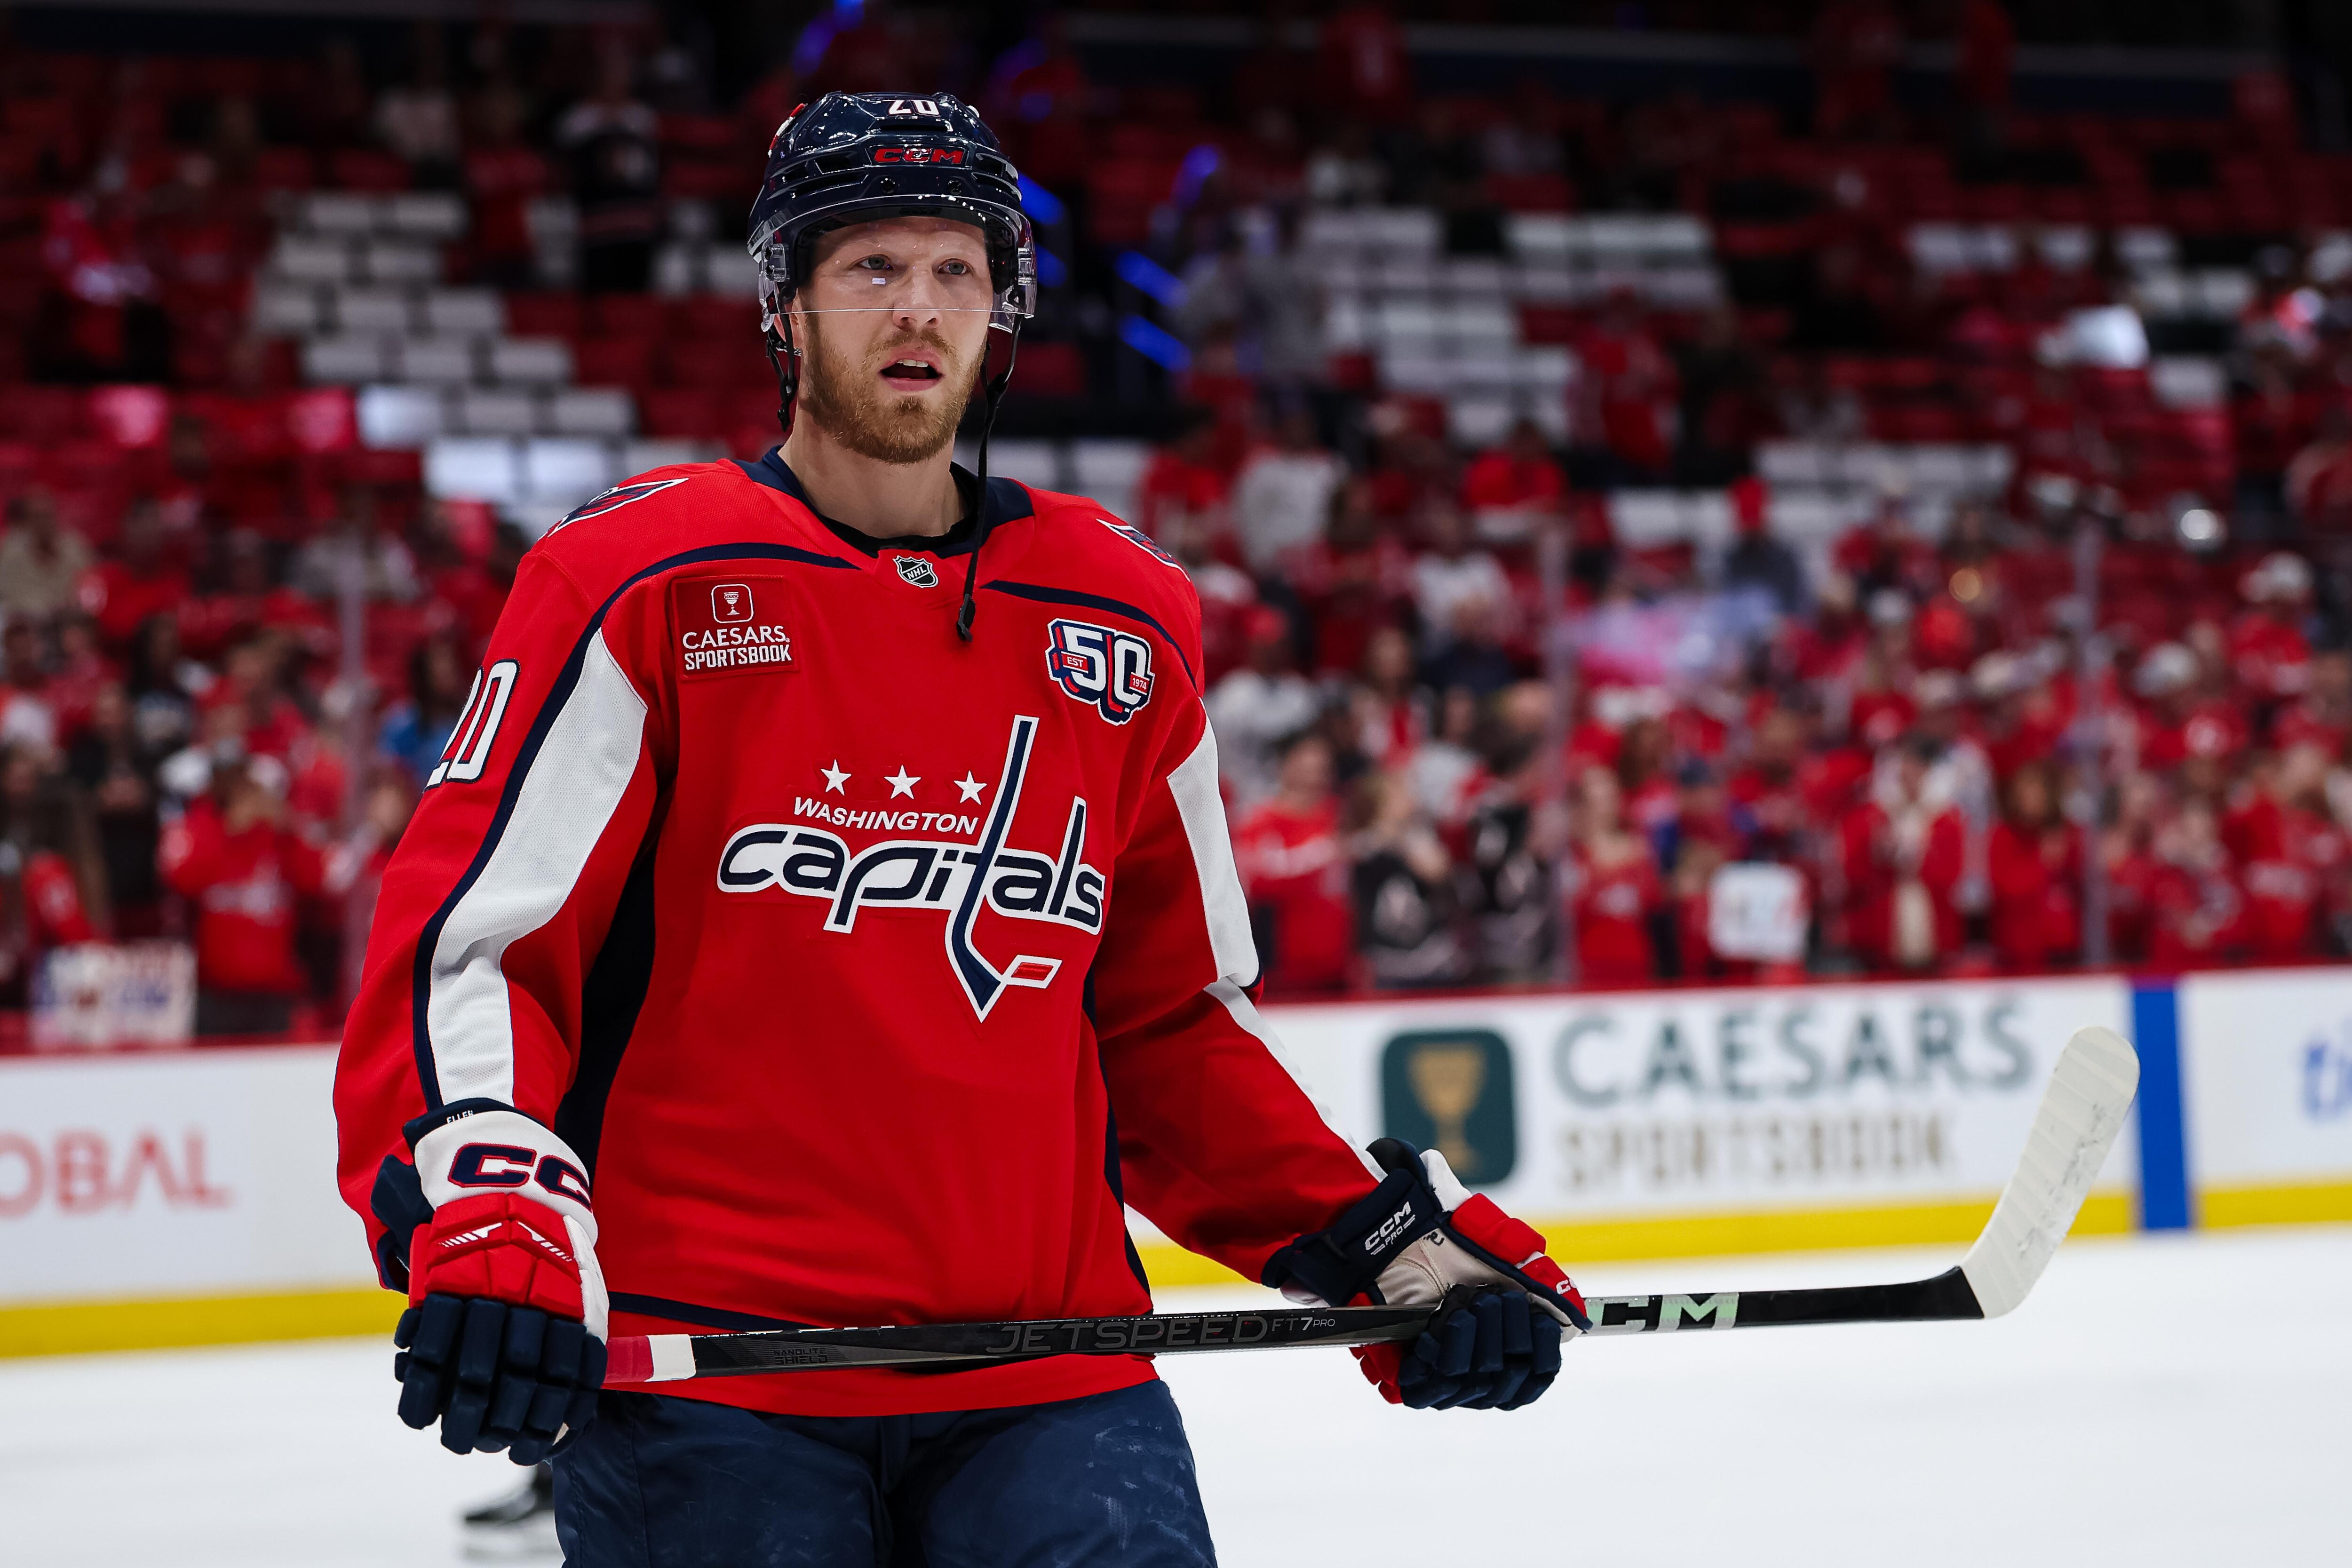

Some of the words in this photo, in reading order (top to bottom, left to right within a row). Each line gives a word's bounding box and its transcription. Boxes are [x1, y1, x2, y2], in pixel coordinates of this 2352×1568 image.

[874, 147, 964, 164] CCM
[906, 565, 927, 580] NHL
[683, 625, 786, 650] CAESARS
[684, 644, 792, 670] SPORTSBOOK
[1062, 625, 1147, 705] 50
[1067, 656, 1084, 668] EST
[1131, 677, 1147, 691] 1974
[793, 796, 979, 836] WASHINGTON
[1552, 1000, 2034, 1110] CAESARS
[1364, 1201, 1412, 1251] CCM
[1384, 1225, 1404, 1245] PRO
[985, 1316, 1269, 1353] JETSPEED
[774, 1354, 828, 1364] SHIELD
